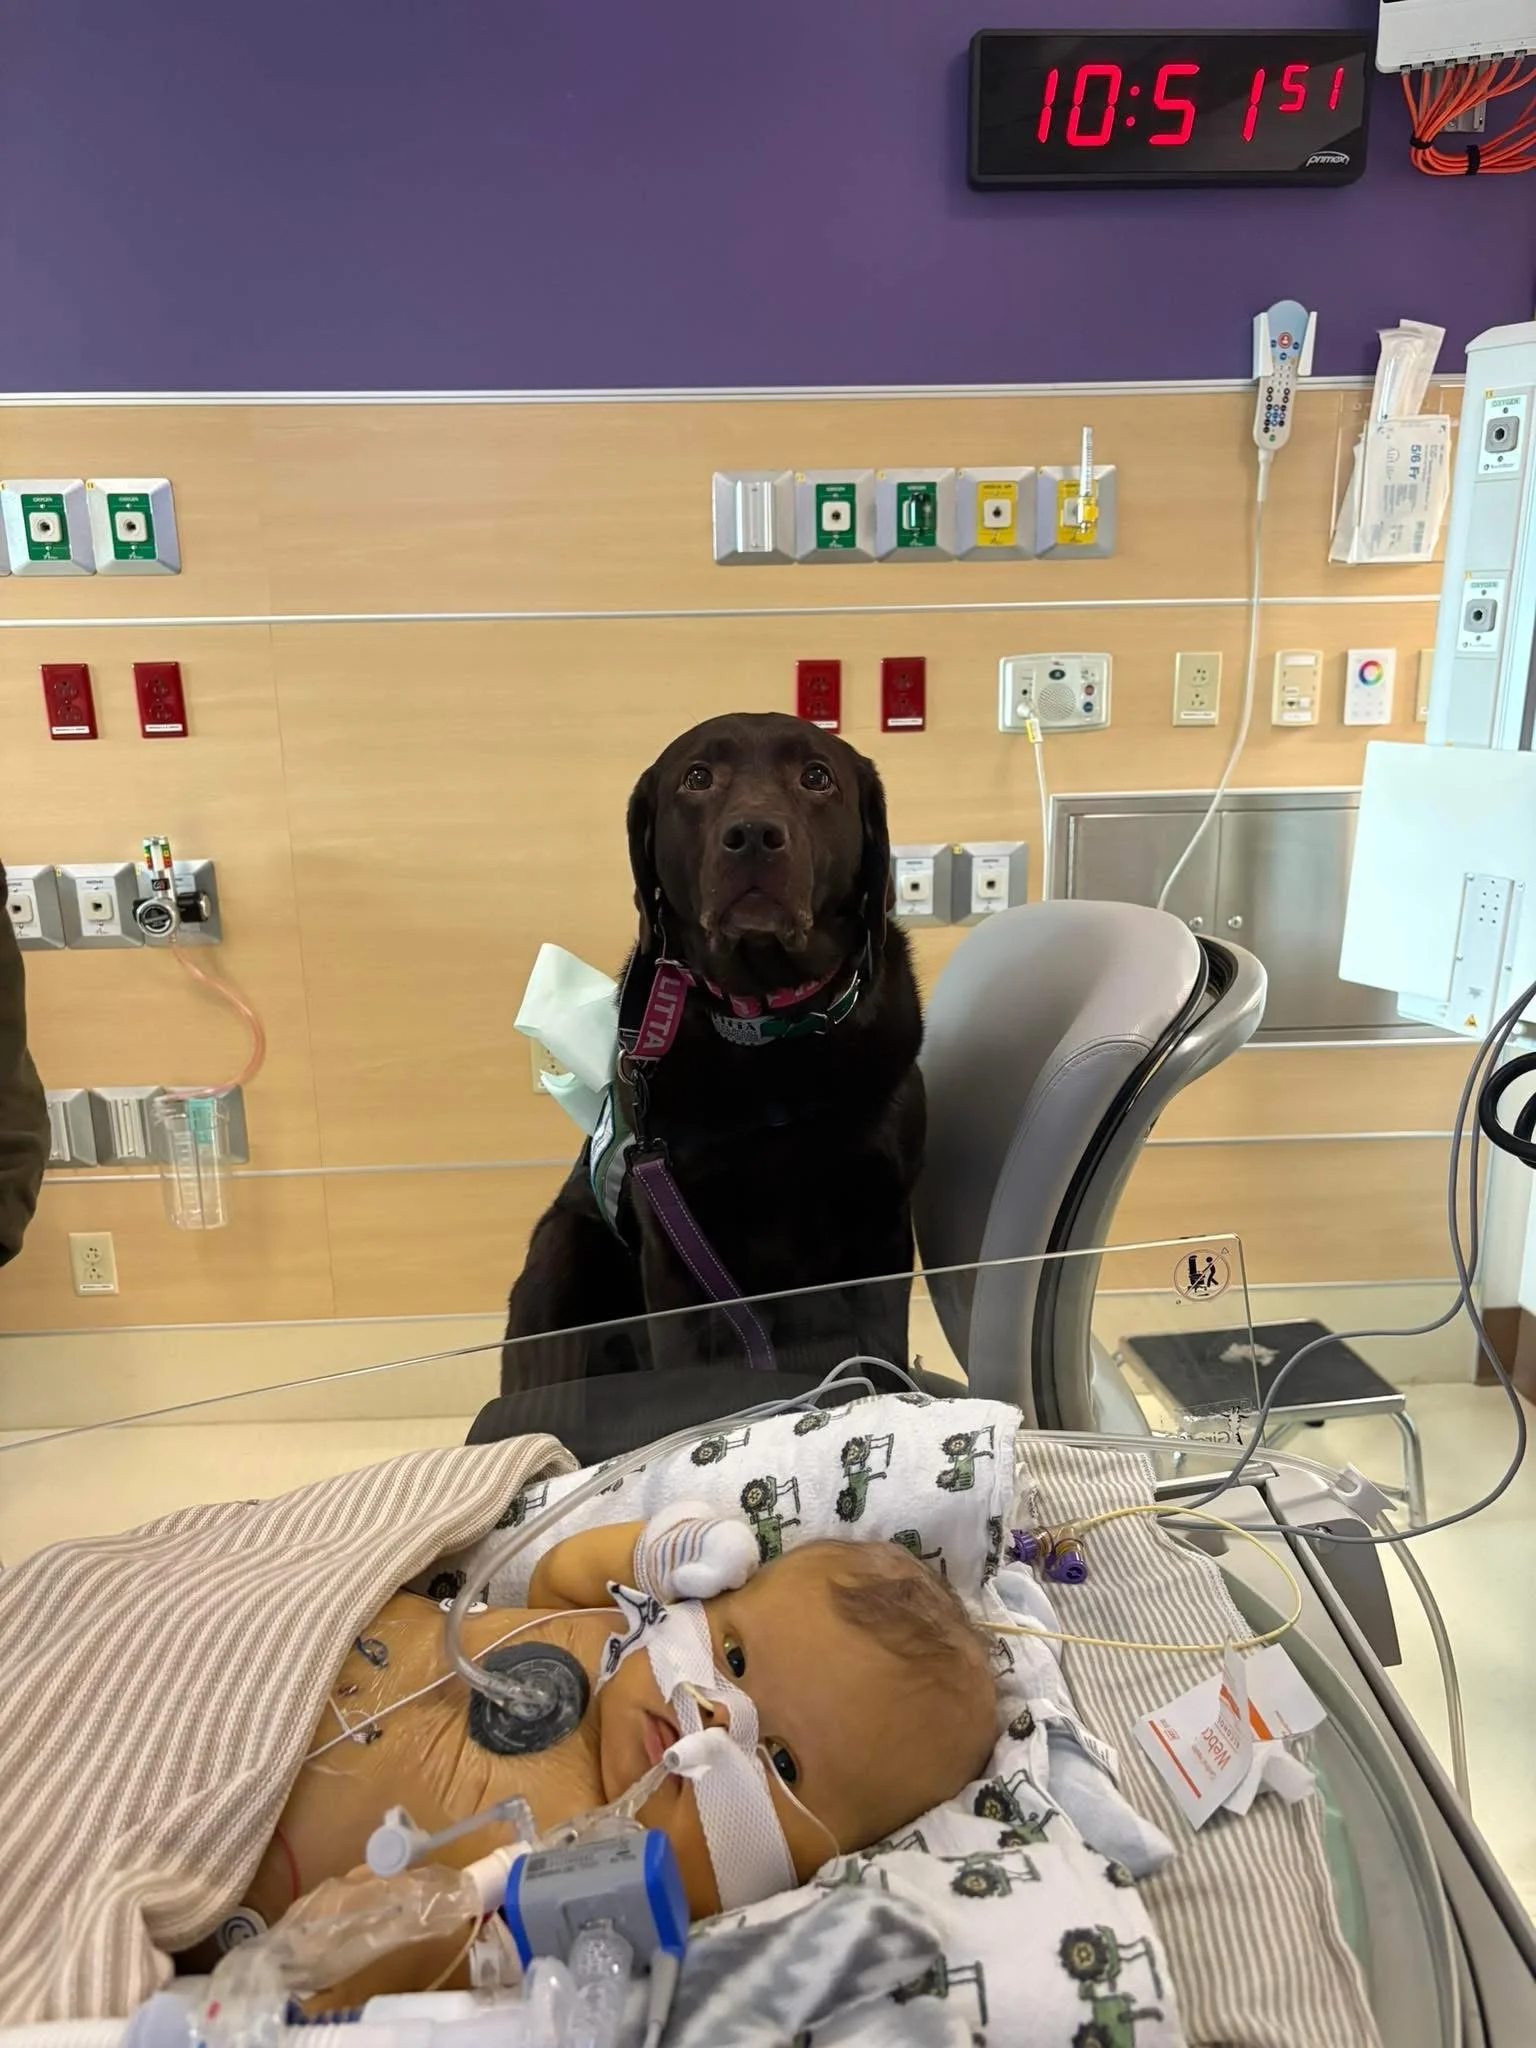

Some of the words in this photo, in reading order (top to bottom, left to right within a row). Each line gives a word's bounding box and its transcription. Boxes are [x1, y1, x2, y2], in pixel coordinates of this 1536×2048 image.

[1037, 64, 1267, 146] 10:51
[1278, 64, 1345, 112] 51
[643, 975, 681, 1049] LITTA
